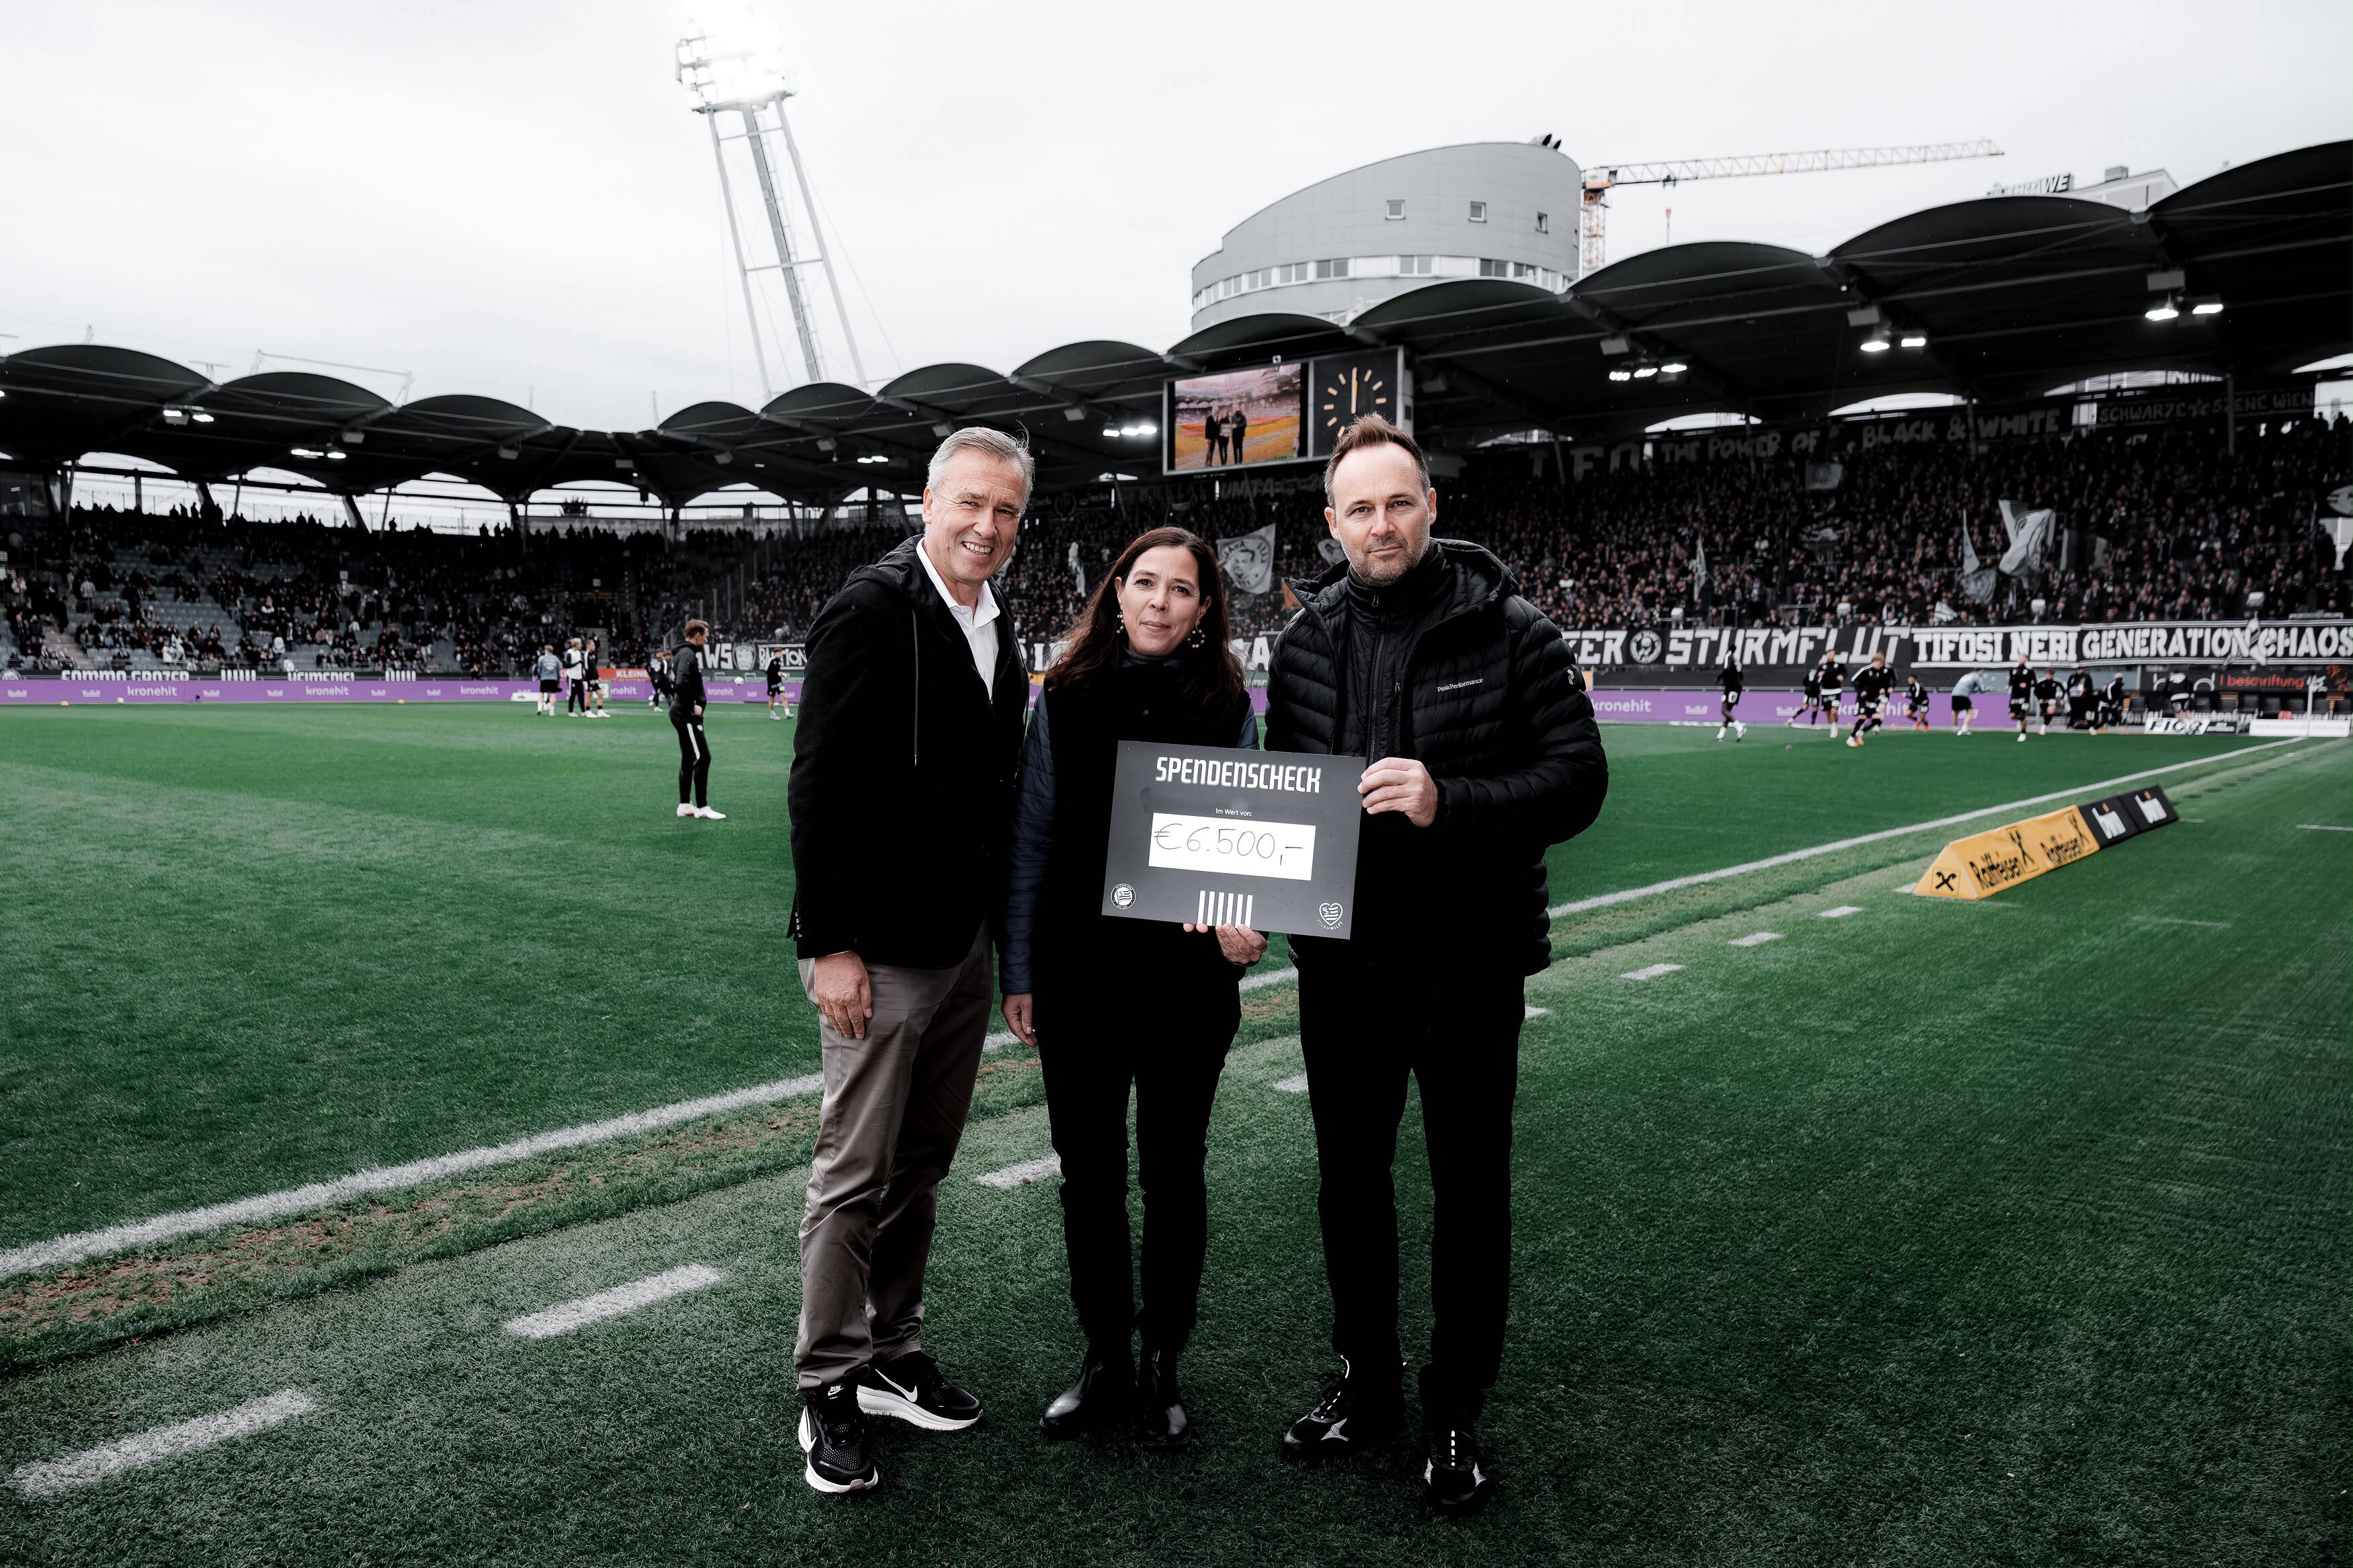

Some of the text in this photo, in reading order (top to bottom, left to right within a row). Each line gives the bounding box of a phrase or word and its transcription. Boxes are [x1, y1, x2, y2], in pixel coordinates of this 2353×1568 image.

[1862, 418, 1937, 450] BLACK
[1977, 407, 2061, 440] WHITE
[1913, 631, 2078, 662] TIFOSI NERI
[2082, 627, 2250, 659] GENERATION
[127, 686, 177, 696] kronehit
[306, 686, 350, 696] kronehit
[461, 686, 500, 696] kronehit
[1156, 756, 1322, 794] SPENDENSCHECK
[830, 1385, 842, 1393] RUN
